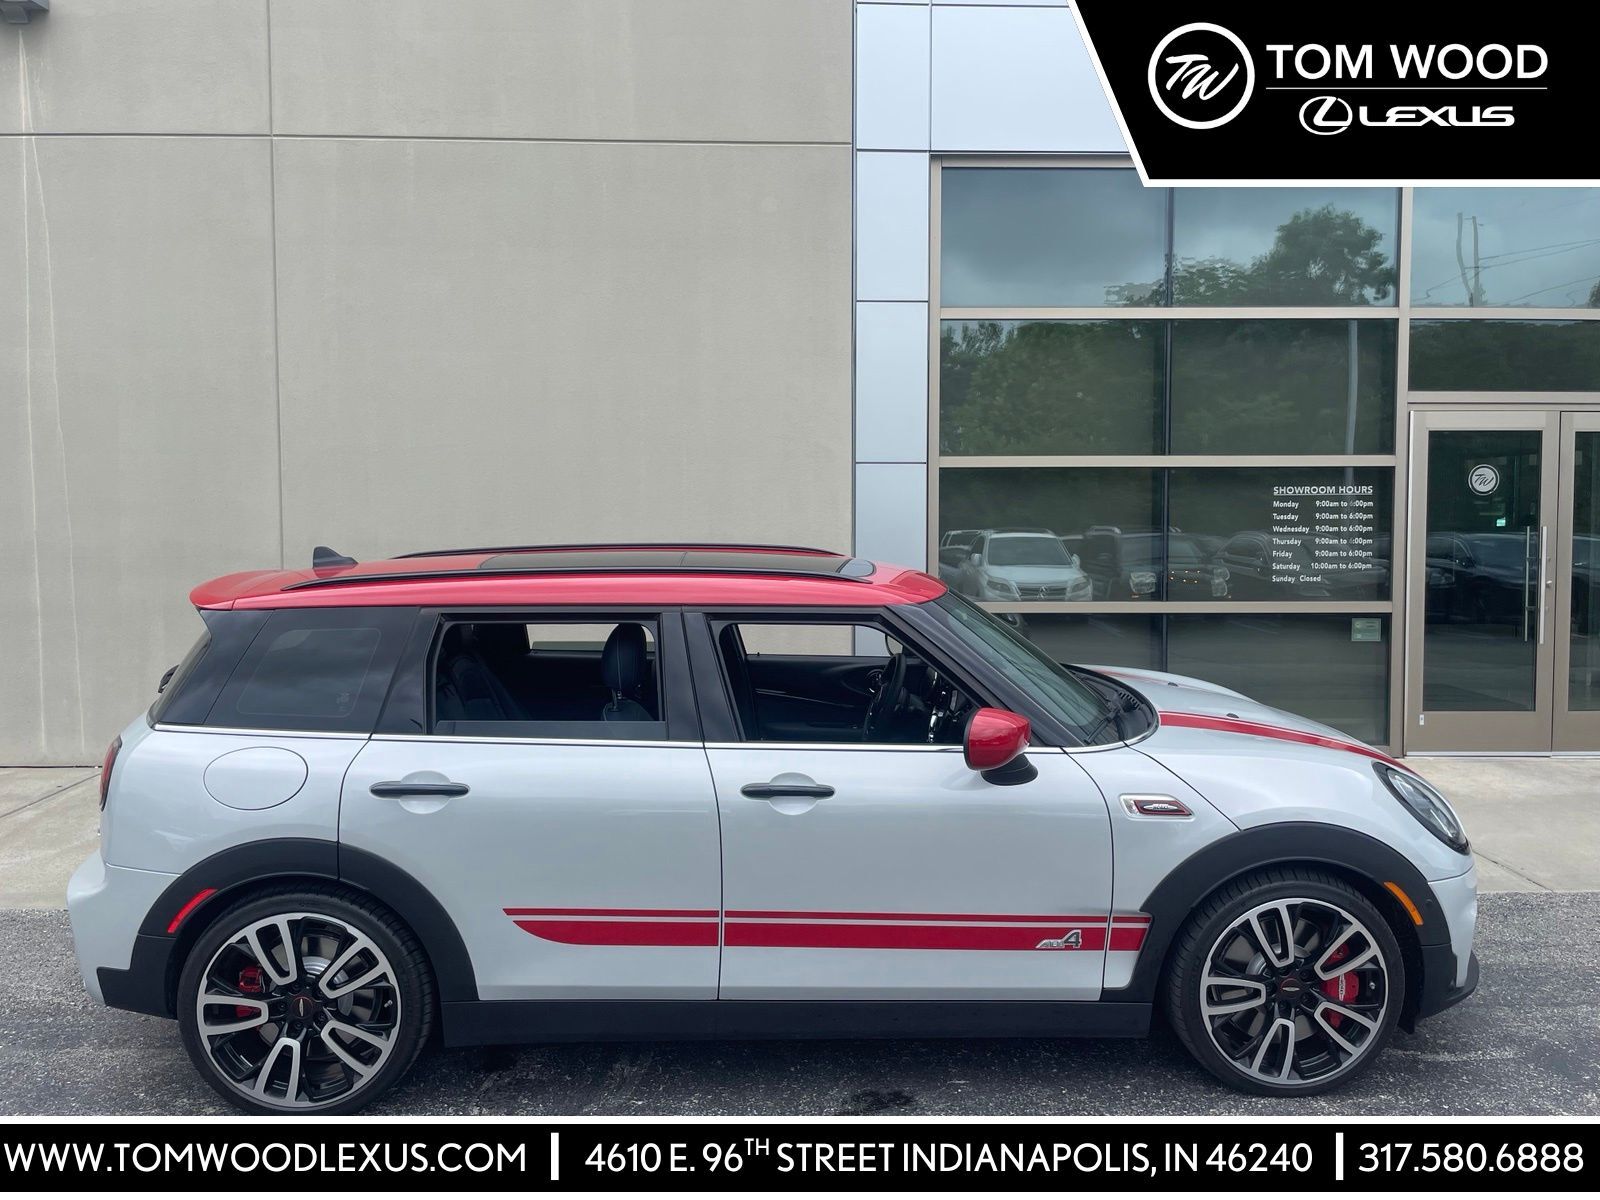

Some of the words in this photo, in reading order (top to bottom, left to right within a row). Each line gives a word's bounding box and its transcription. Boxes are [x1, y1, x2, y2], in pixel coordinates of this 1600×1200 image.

[1273, 486, 1336, 494] SHOWROOM
[1339, 485, 1373, 494] HOURS
[1273, 500, 1299, 509] Monday
[1315, 500, 1339, 508] 9:00am
[1272, 513, 1299, 521] Tuesday
[1349, 512, 1374, 521] 6:00pm
[1272, 525, 1310, 533] Wednesday
[1348, 525, 1373, 533] 6:00pm
[1272, 538, 1302, 546] Thursday
[1272, 550, 1293, 559] Friday
[1348, 550, 1373, 558] 6:00pm
[1272, 562, 1301, 571] Saturday
[1347, 562, 1372, 571] 6:00pm
[1271, 575, 1296, 584] Sunday
